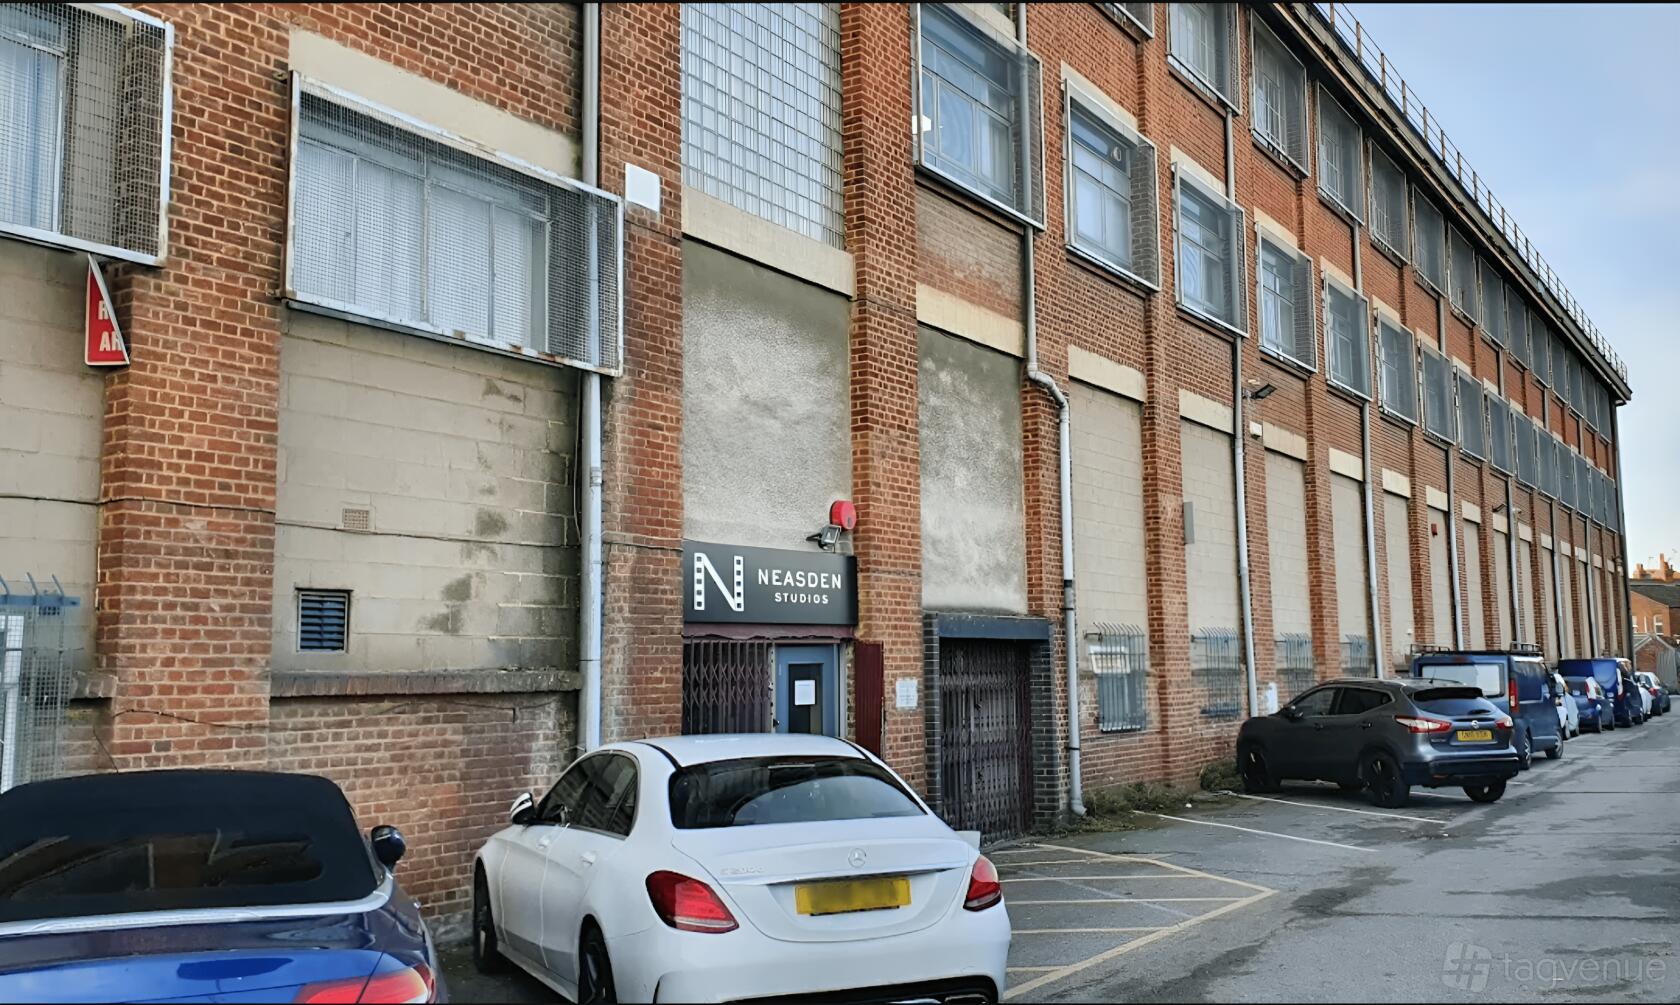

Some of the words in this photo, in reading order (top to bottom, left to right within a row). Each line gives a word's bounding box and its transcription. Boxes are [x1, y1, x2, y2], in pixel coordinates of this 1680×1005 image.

[694, 552, 744, 612] N
[758, 568, 842, 589] NEASDEN
[774, 592, 829, 604] STUDIOS
